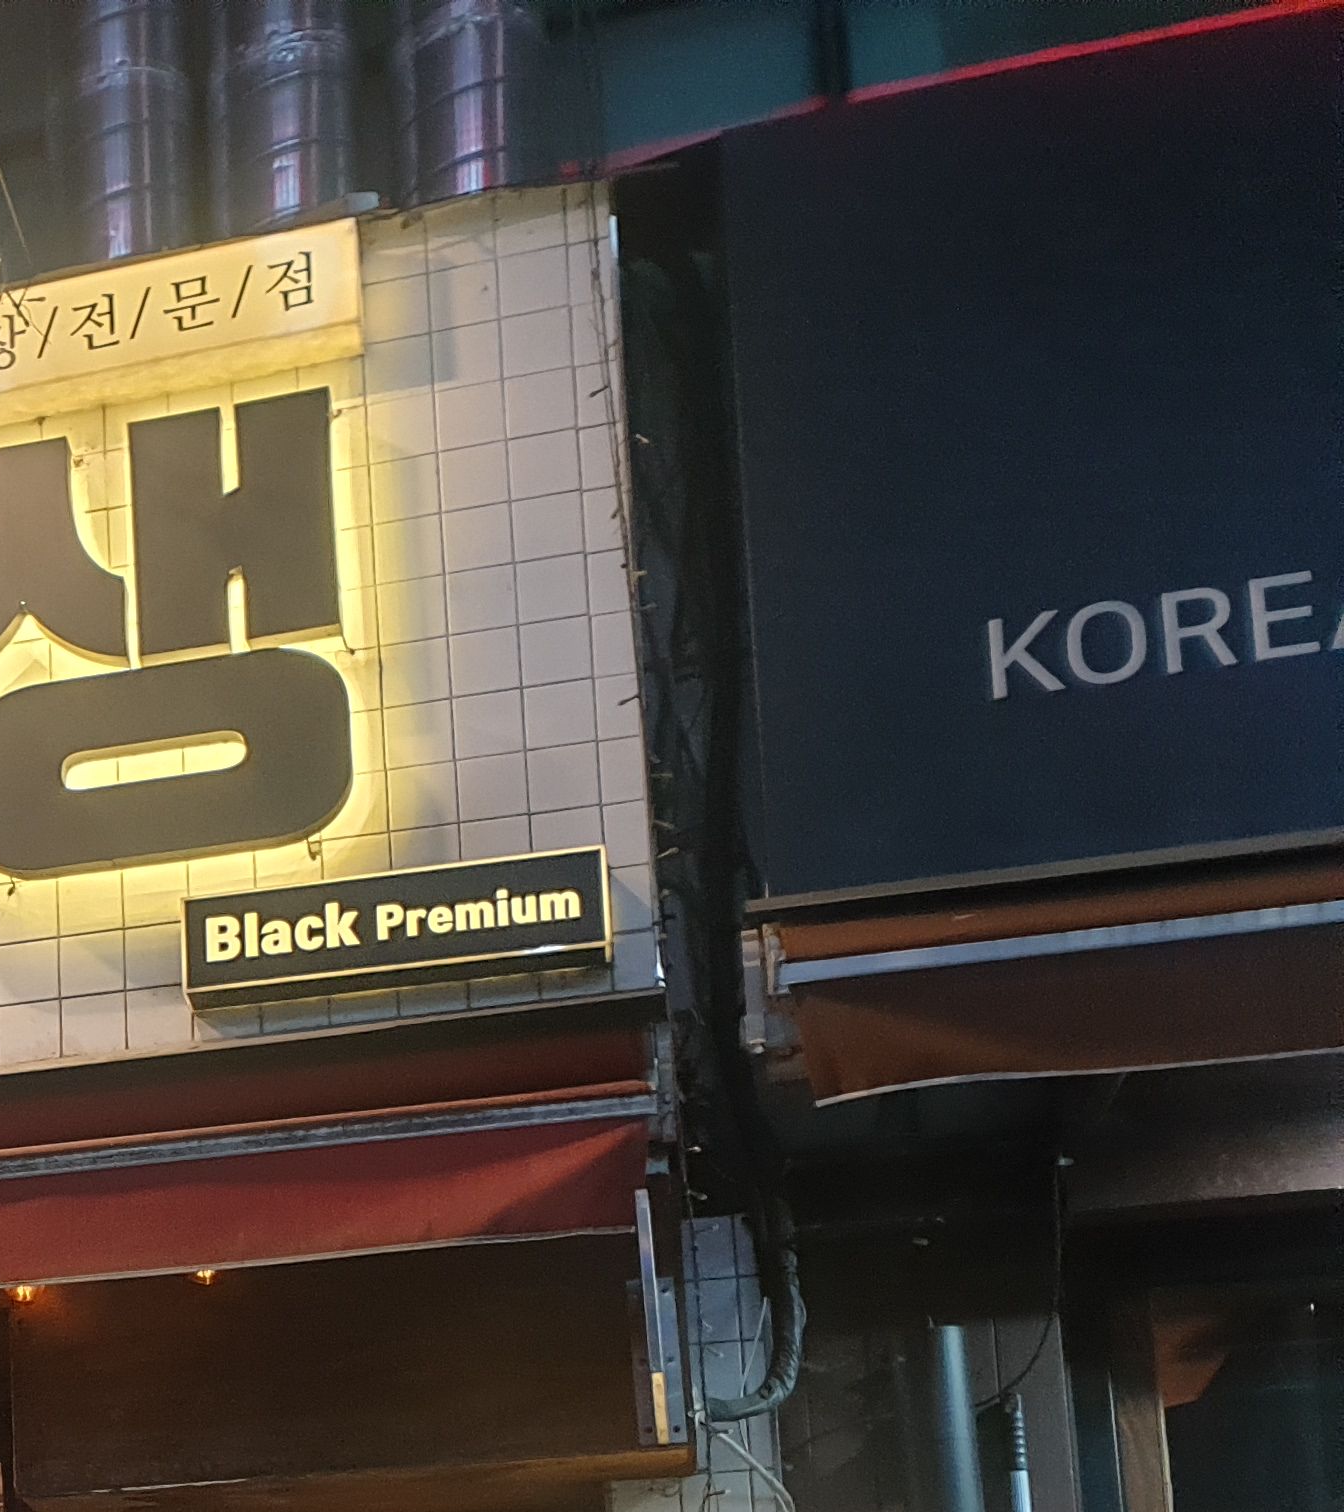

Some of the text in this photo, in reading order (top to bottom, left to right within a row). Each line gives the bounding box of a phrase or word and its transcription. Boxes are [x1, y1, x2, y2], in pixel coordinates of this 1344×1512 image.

[987, 569, 1344, 700] KORE
[204, 887, 582, 963] Black Premium
